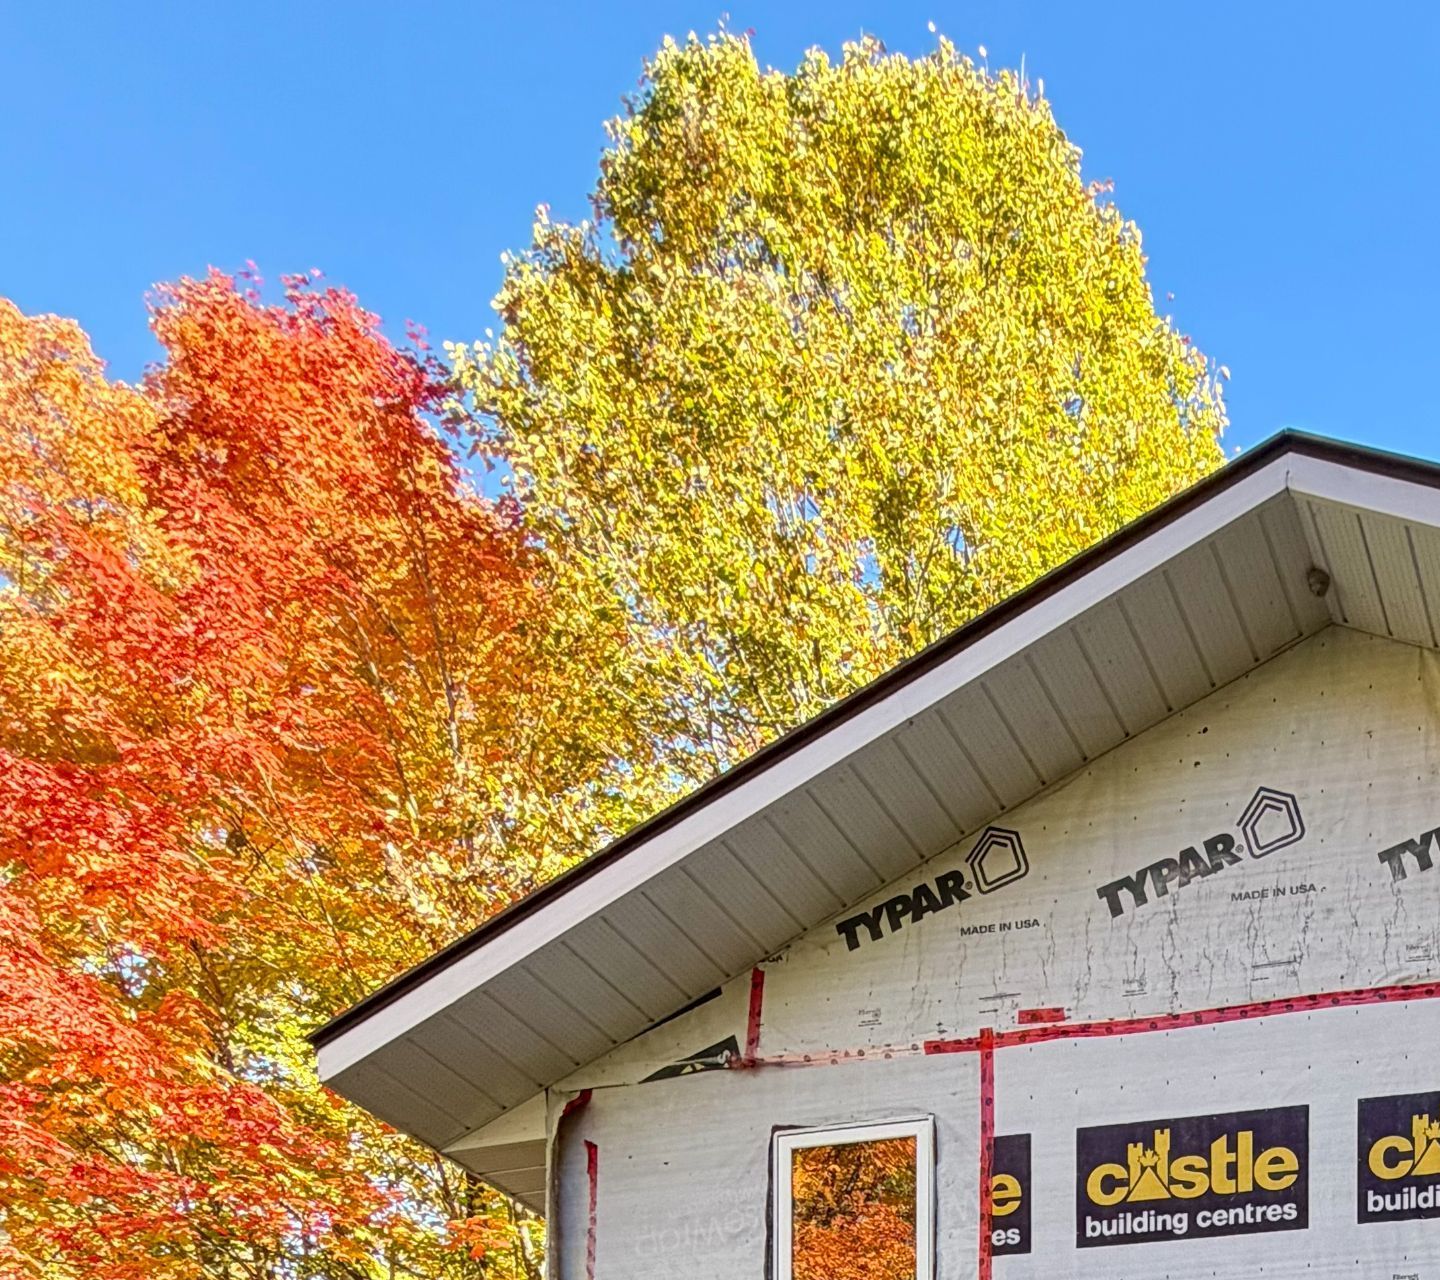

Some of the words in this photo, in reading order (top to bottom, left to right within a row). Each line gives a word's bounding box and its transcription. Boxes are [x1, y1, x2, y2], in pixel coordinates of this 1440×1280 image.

[1097, 833, 1243, 918] TYPAR
[1231, 890, 1270, 902] MADE
[1273, 887, 1285, 899] IN
[1289, 883, 1316, 895] USA
[836, 869, 971, 951] TYPAR
[960, 924, 996, 936] MADE
[1000, 922, 1011, 933] IN
[1013, 919, 1040, 931] USA
[1086, 1128, 1300, 1206] castle
[1085, 1211, 1189, 1238] building
[1196, 1202, 1298, 1228] centres
